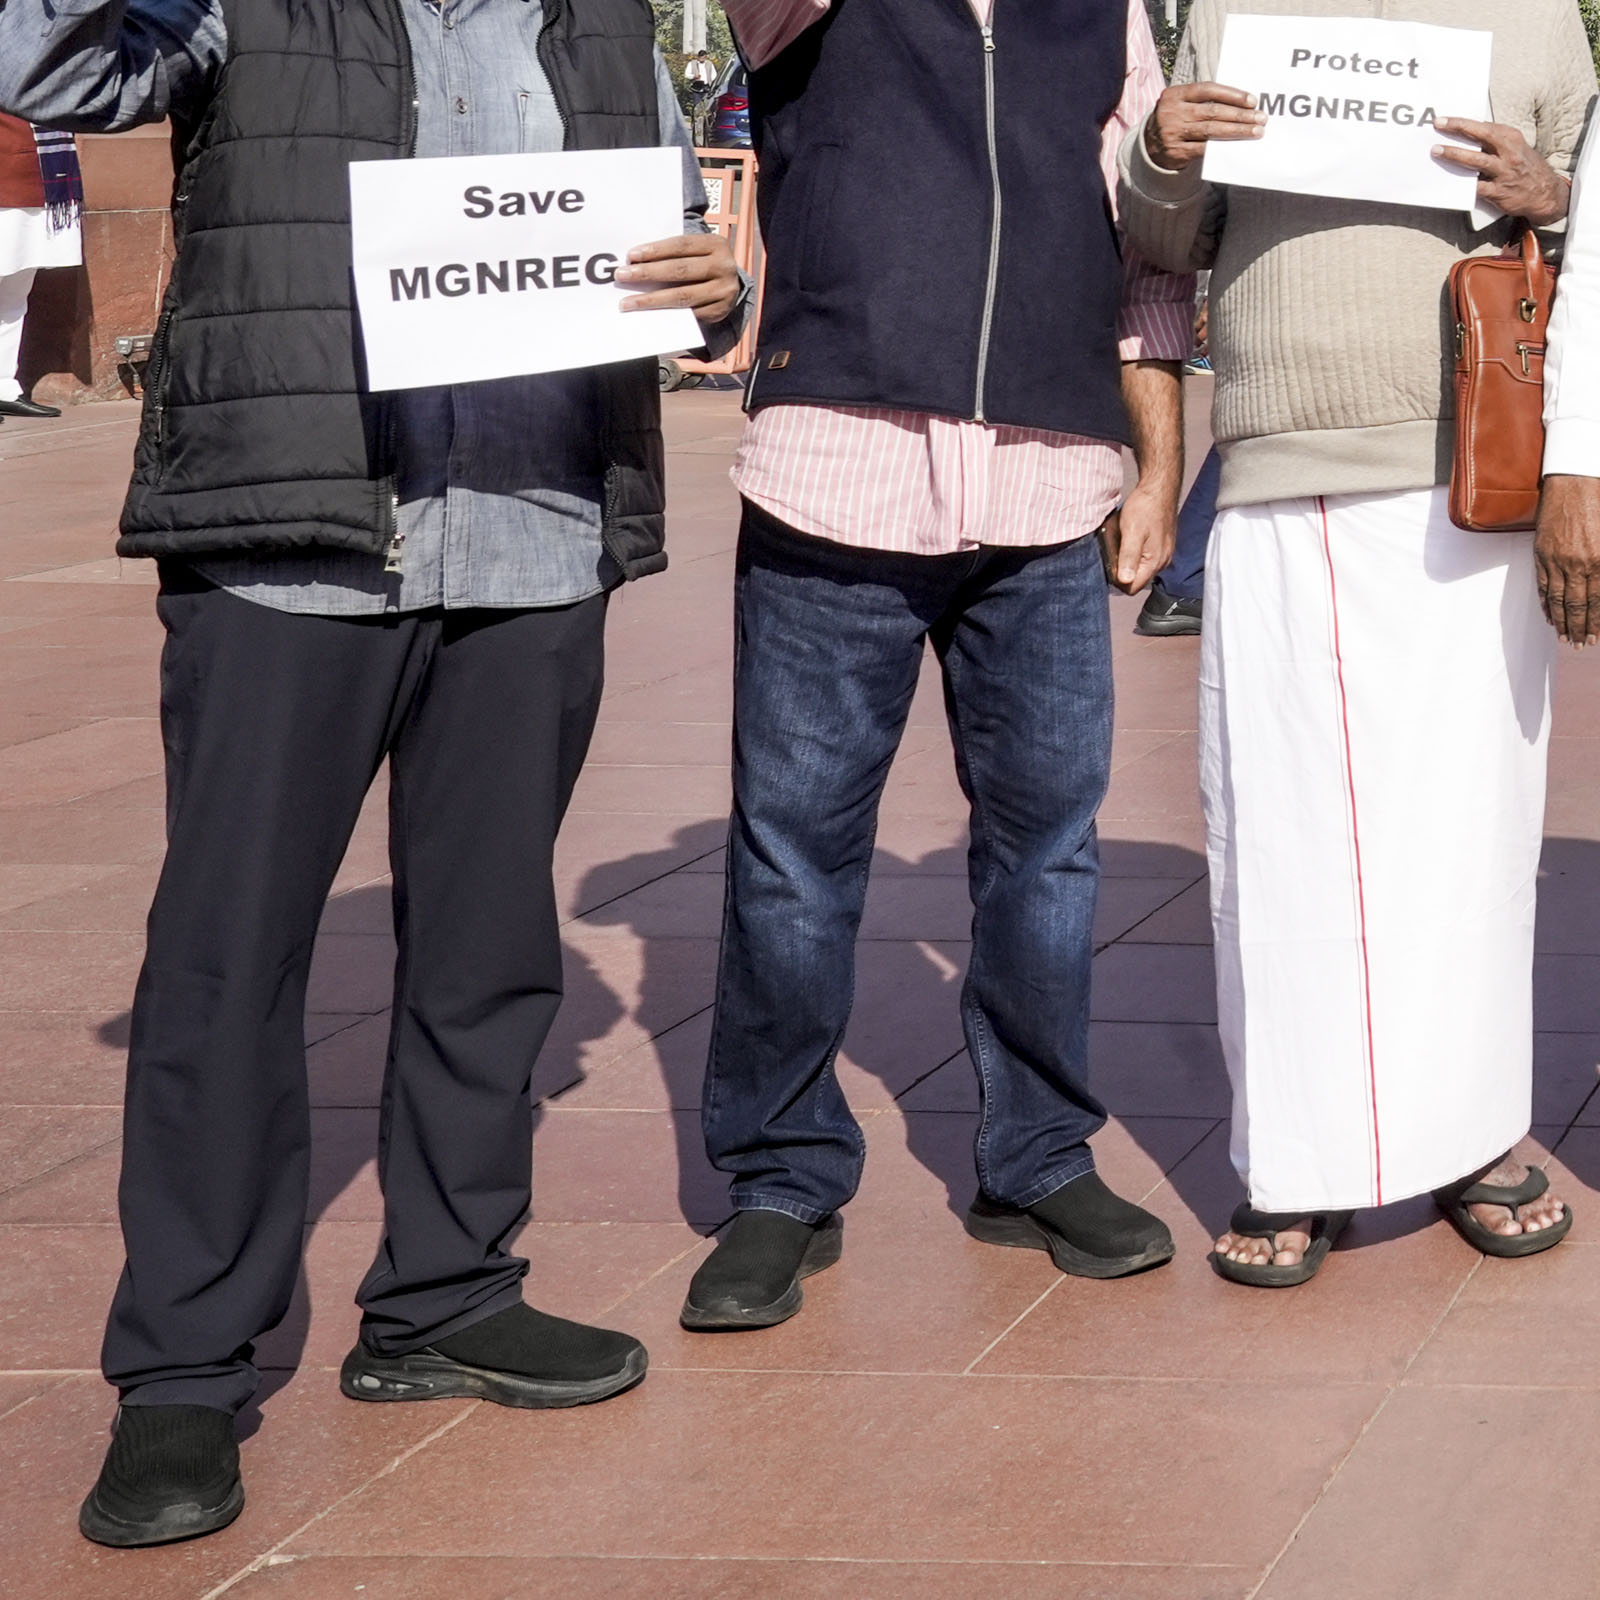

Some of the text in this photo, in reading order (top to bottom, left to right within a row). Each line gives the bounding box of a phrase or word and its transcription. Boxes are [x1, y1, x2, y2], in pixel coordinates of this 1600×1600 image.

[1291, 49, 1419, 78] Protect
[1258, 92, 1437, 128] MGNREGA
[464, 186, 584, 218] Save
[389, 253, 618, 302] MGNREG
